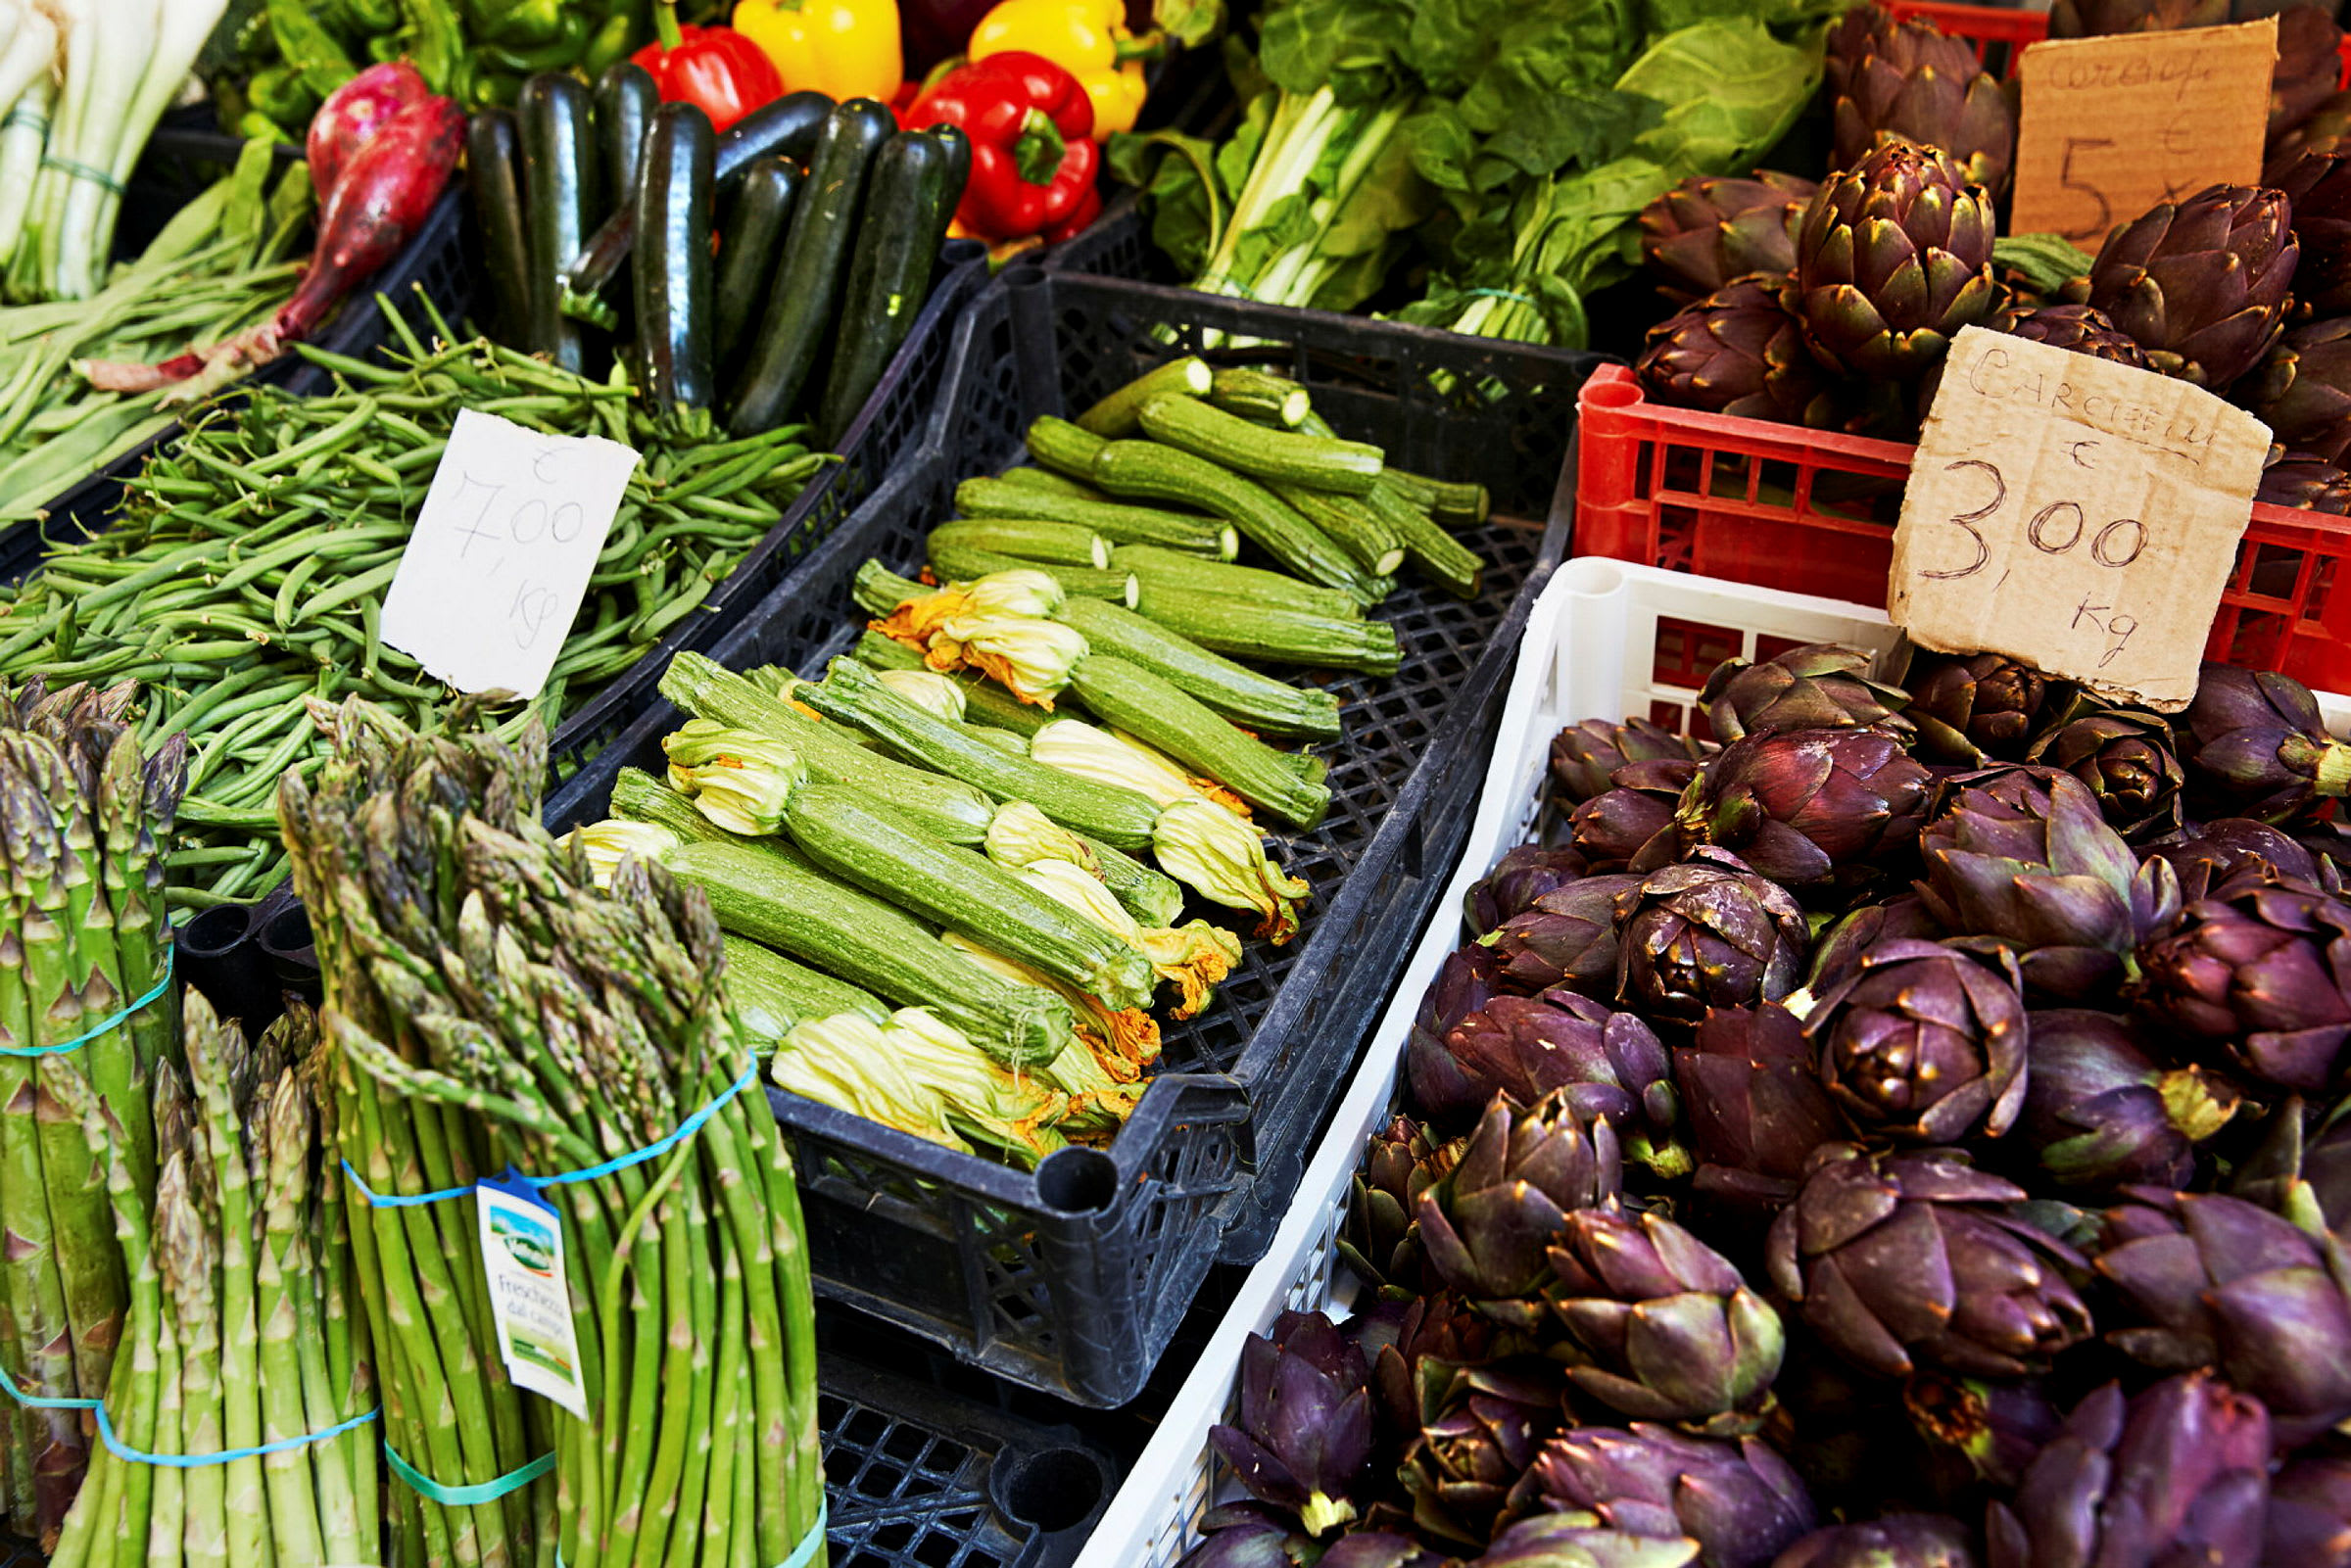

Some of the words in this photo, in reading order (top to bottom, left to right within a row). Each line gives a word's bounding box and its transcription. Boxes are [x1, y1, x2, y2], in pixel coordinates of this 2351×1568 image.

[2061, 137, 2116, 240] 5
[533, 446, 577, 484] €
[2061, 440, 2100, 470] €
[454, 470, 584, 578] 7,00
[1917, 459, 2150, 593] 3,00
